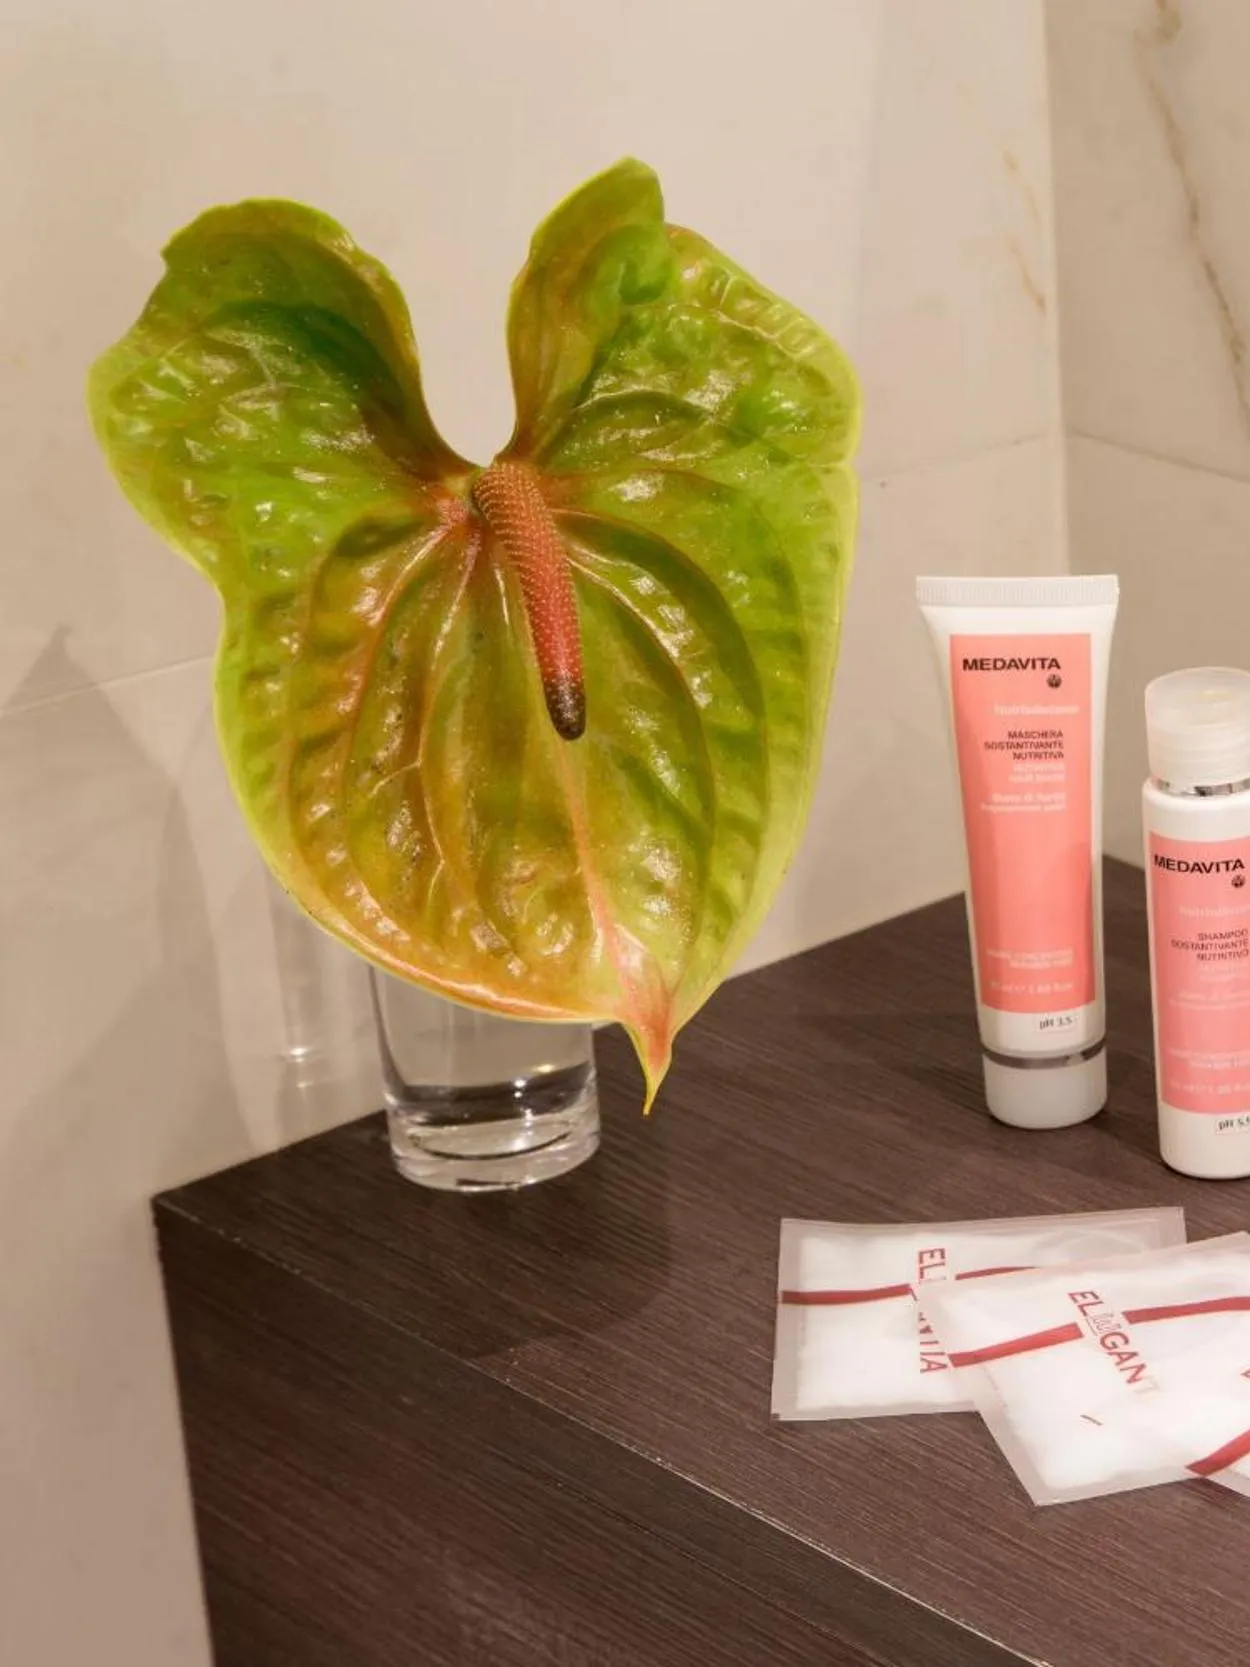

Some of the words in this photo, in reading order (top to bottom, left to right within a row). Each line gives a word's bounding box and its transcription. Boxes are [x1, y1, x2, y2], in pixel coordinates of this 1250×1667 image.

[962, 657, 1061, 671] MEDAVITA
[1007, 730, 1064, 739] MASCHERA
[1154, 854, 1245, 874] MEDAVITA
[1198, 928, 1249, 941] SHAMPOO
